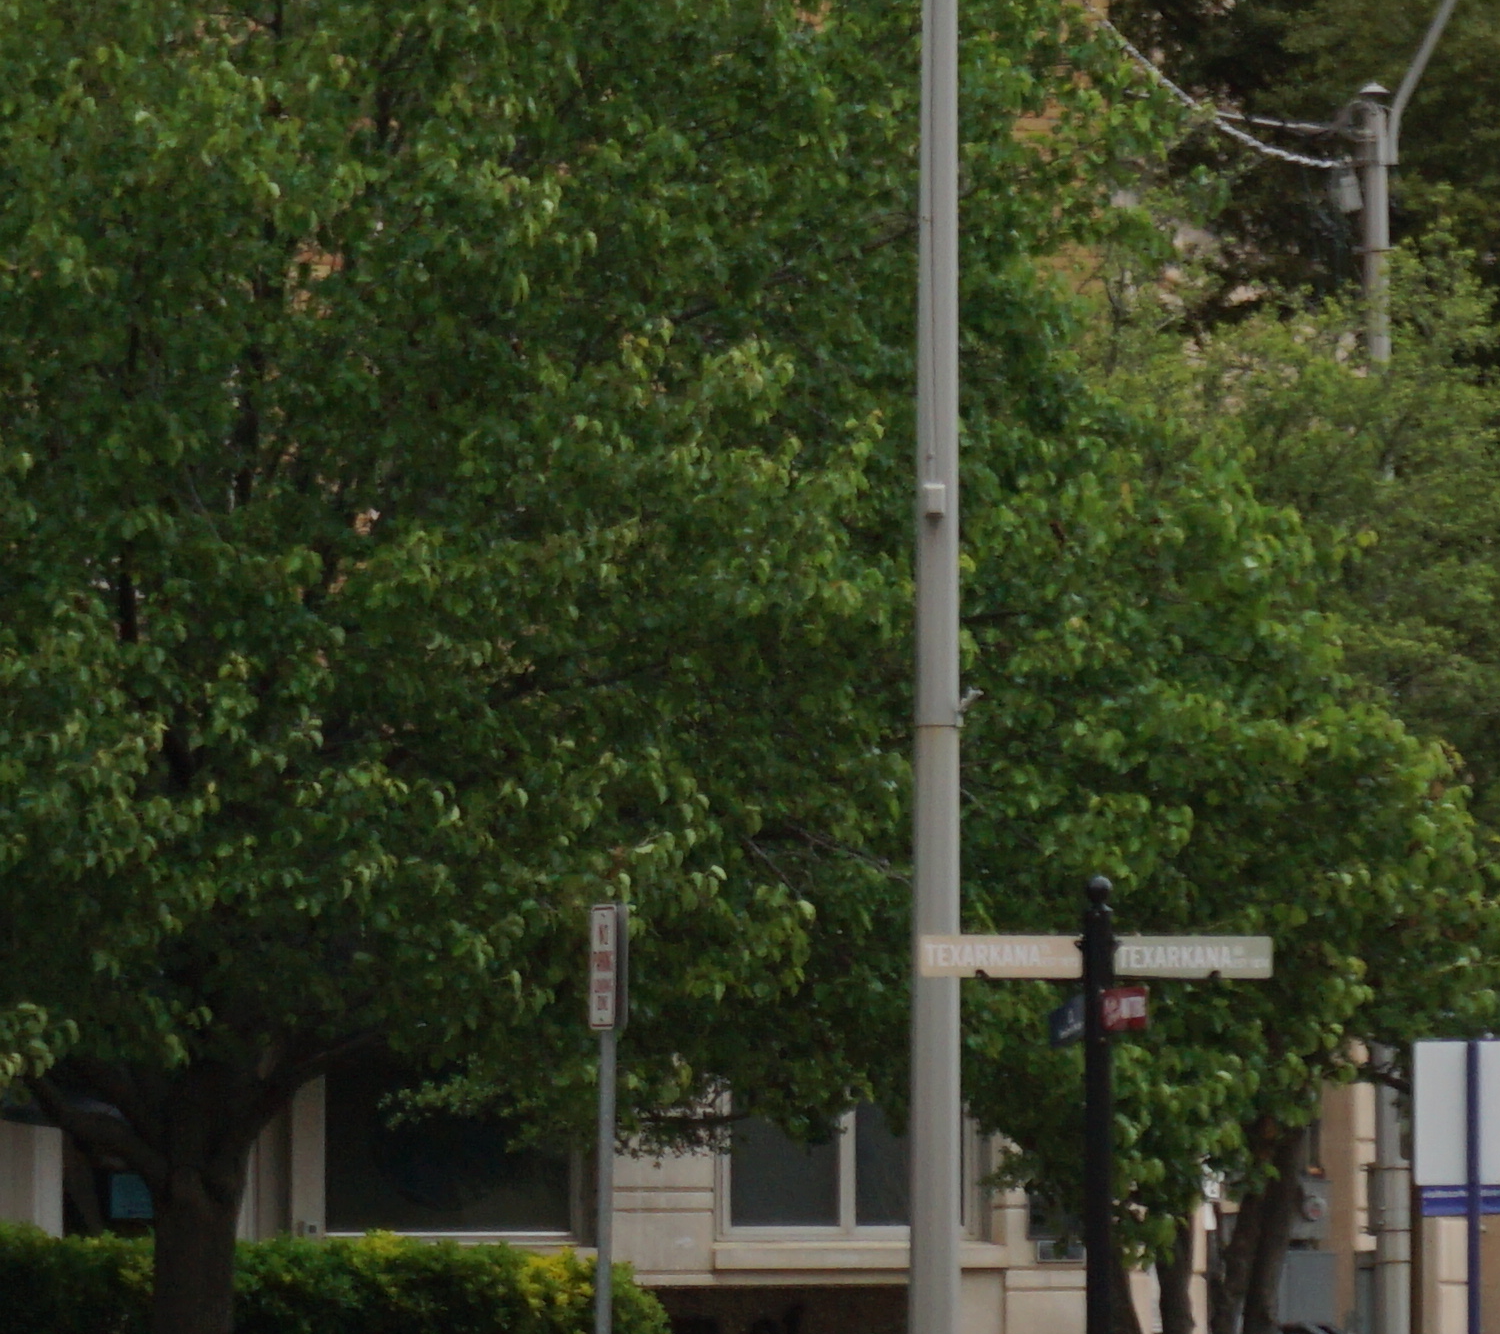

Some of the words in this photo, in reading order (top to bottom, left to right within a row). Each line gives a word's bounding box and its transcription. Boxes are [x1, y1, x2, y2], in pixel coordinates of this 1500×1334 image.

[598, 923, 609, 946] NO
[925, 943, 1040, 967] TEXARKANA
[1117, 945, 1231, 968] TEXARKANA
